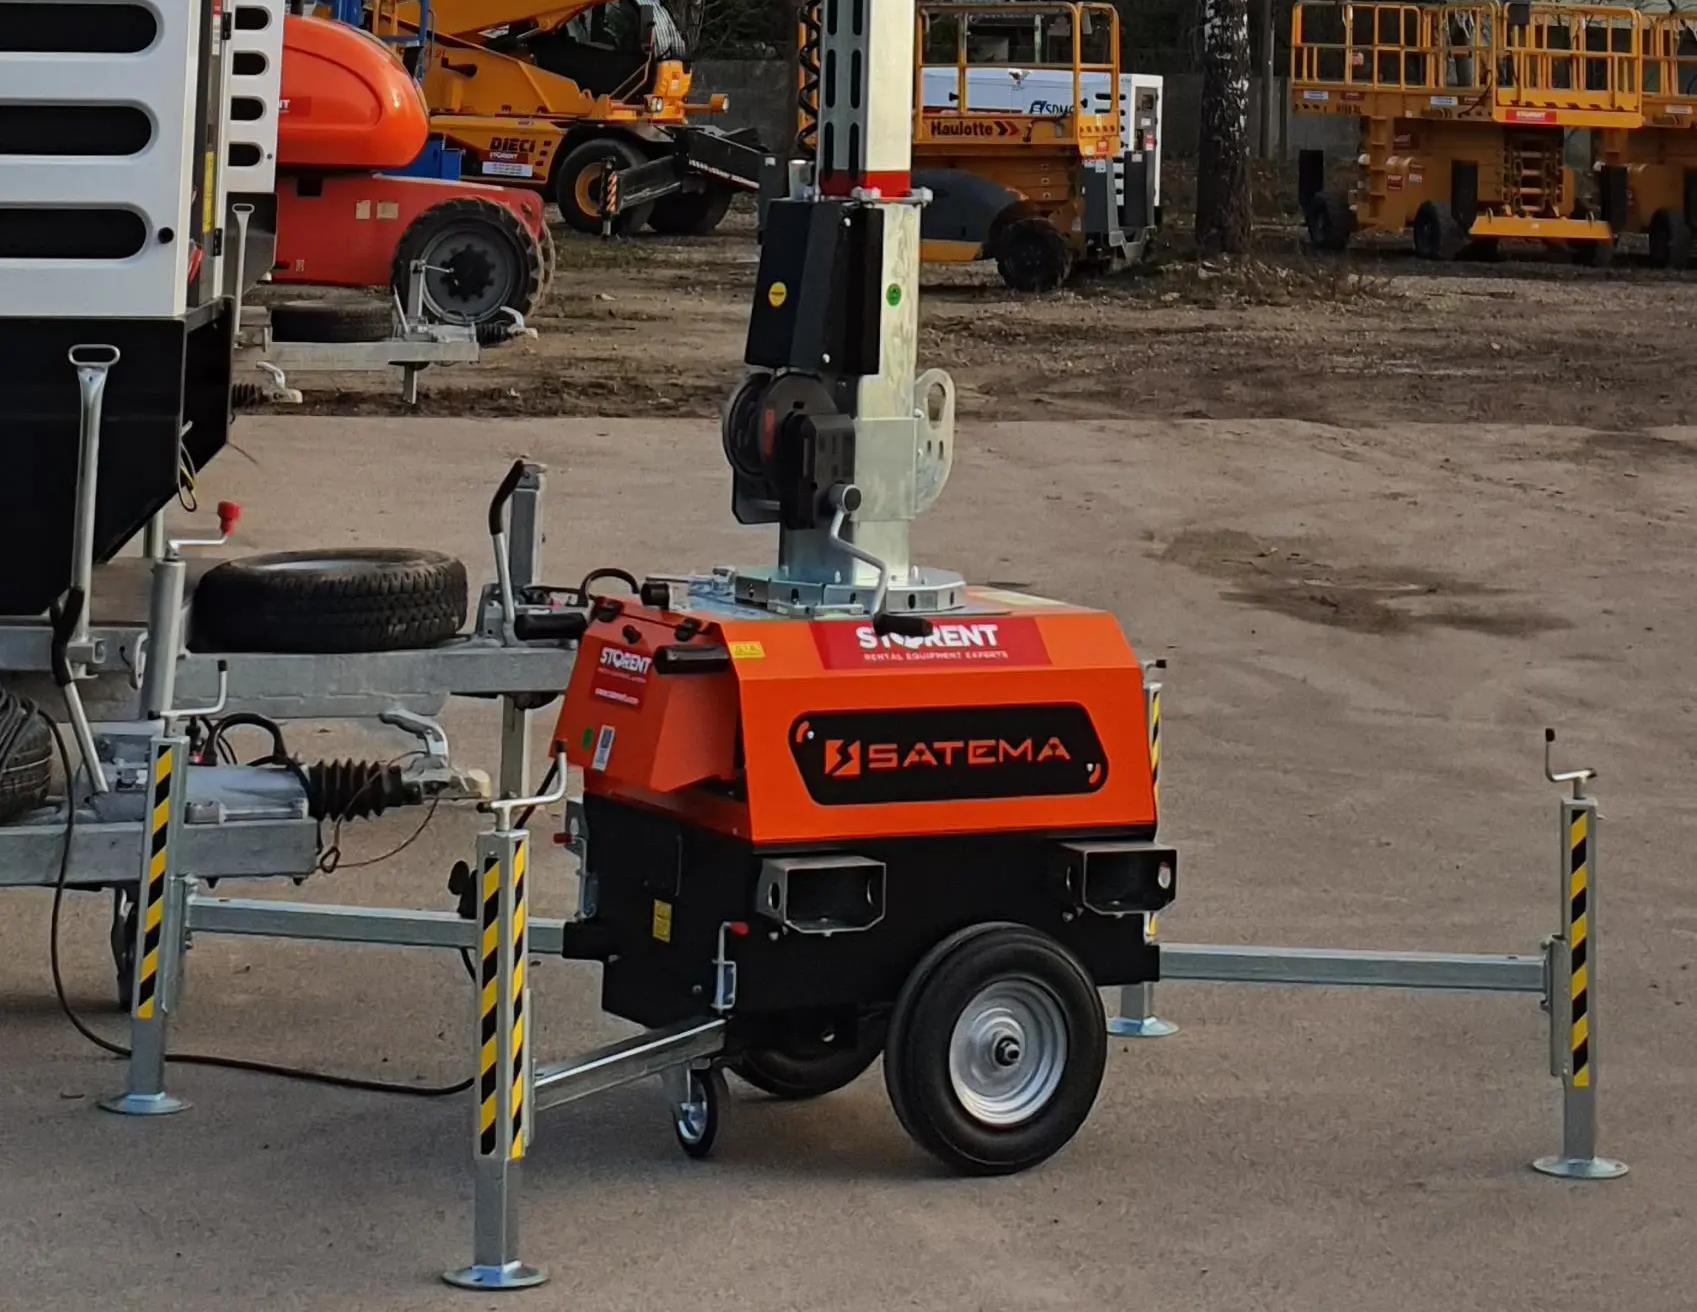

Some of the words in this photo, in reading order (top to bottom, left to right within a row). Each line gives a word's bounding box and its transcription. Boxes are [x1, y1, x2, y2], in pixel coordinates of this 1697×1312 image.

[931, 120, 993, 137] Haulotte
[489, 136, 536, 154] DIECI
[600, 646, 652, 675] STORENT
[864, 652, 904, 662] RENTAL
[905, 651, 962, 661] EQUIPMENT
[867, 736, 1072, 769] SATEMA
